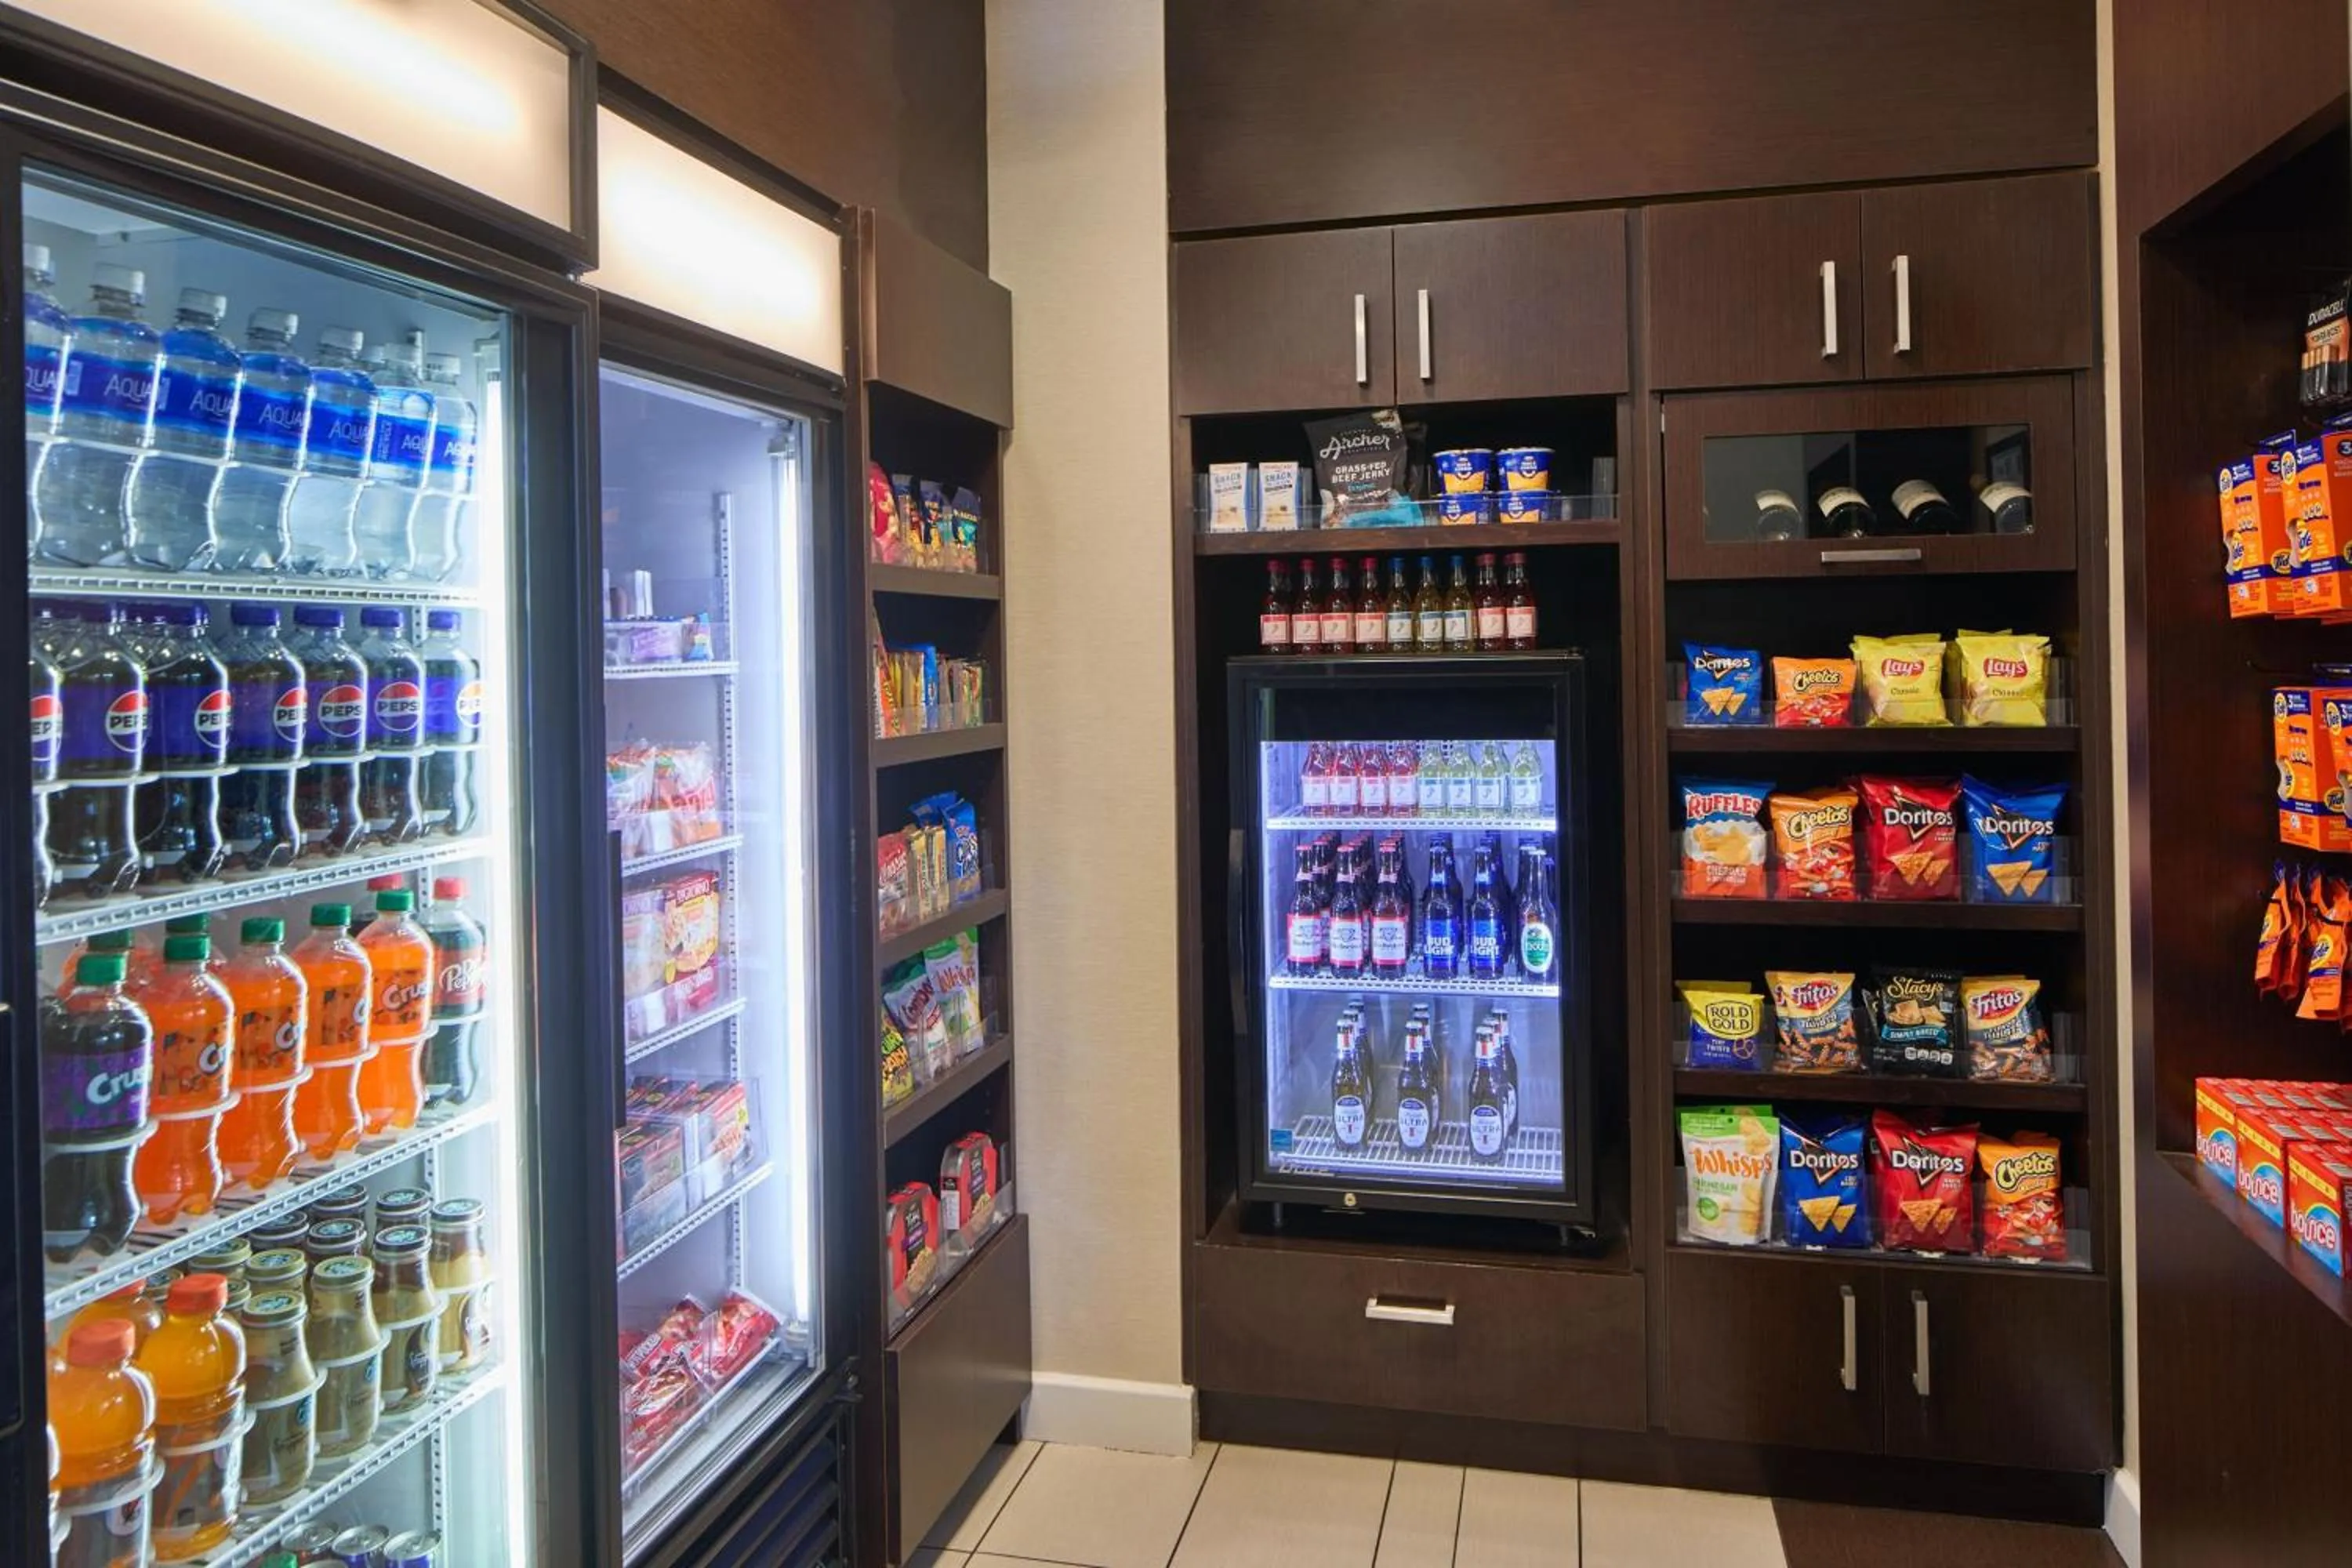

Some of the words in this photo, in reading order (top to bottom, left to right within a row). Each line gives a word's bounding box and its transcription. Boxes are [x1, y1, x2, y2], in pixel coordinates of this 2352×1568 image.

[1319, 434, 1389, 460] Archer
[1695, 656, 1751, 671] Doritos
[1794, 670, 1840, 691] Cheetos
[1687, 793, 1762, 819] RUFFLES
[1884, 808, 1953, 825] Doritos
[1788, 806, 1849, 839] Cheetos
[1985, 817, 2054, 835] Doritos
[1792, 985, 1838, 1007] Fritos
[1972, 989, 2023, 1017] Fritos
[1711, 1006, 1750, 1018] ROLD
[1711, 1018, 1750, 1030] GOLD
[1791, 1150, 1858, 1168] Doritos
[2196, 1126, 2233, 1167] bounce
[1690, 1147, 1773, 1179] Whisps
[1892, 1149, 1964, 1173] Doritos
[1996, 1155, 2056, 1189] Cheetos
[2238, 1156, 2279, 1204] bounce
[2290, 1198, 2336, 1250] bounce
